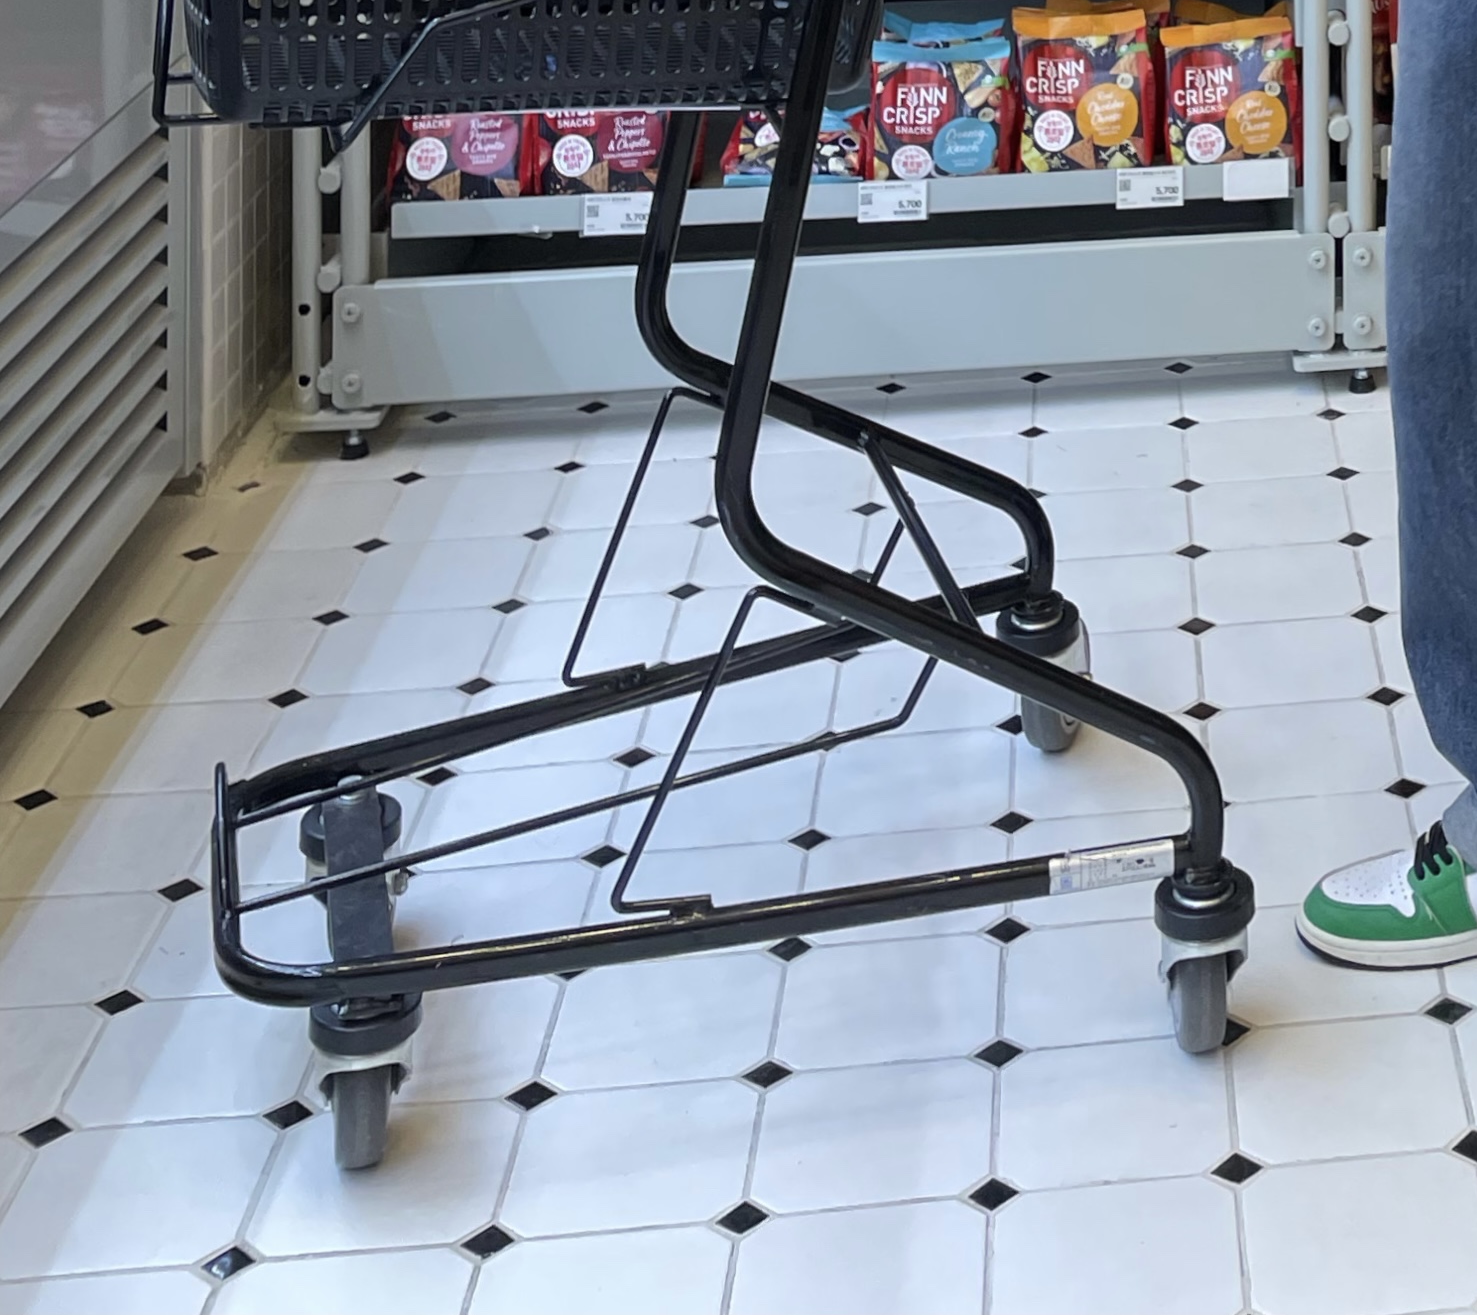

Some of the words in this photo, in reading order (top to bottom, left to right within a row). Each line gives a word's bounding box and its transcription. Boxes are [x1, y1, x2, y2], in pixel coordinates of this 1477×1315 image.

[1025, 76, 1080, 95] CRISP
[1038, 94, 1075, 105] SNACKS
[1174, 86, 1229, 106] CRISP
[882, 106, 941, 125] CRISP
[1186, 104, 1225, 116] SNACKS
[412, 118, 452, 131] SNACKS
[557, 117, 596, 129] SNACKS
[894, 126, 934, 136] SNACKS
